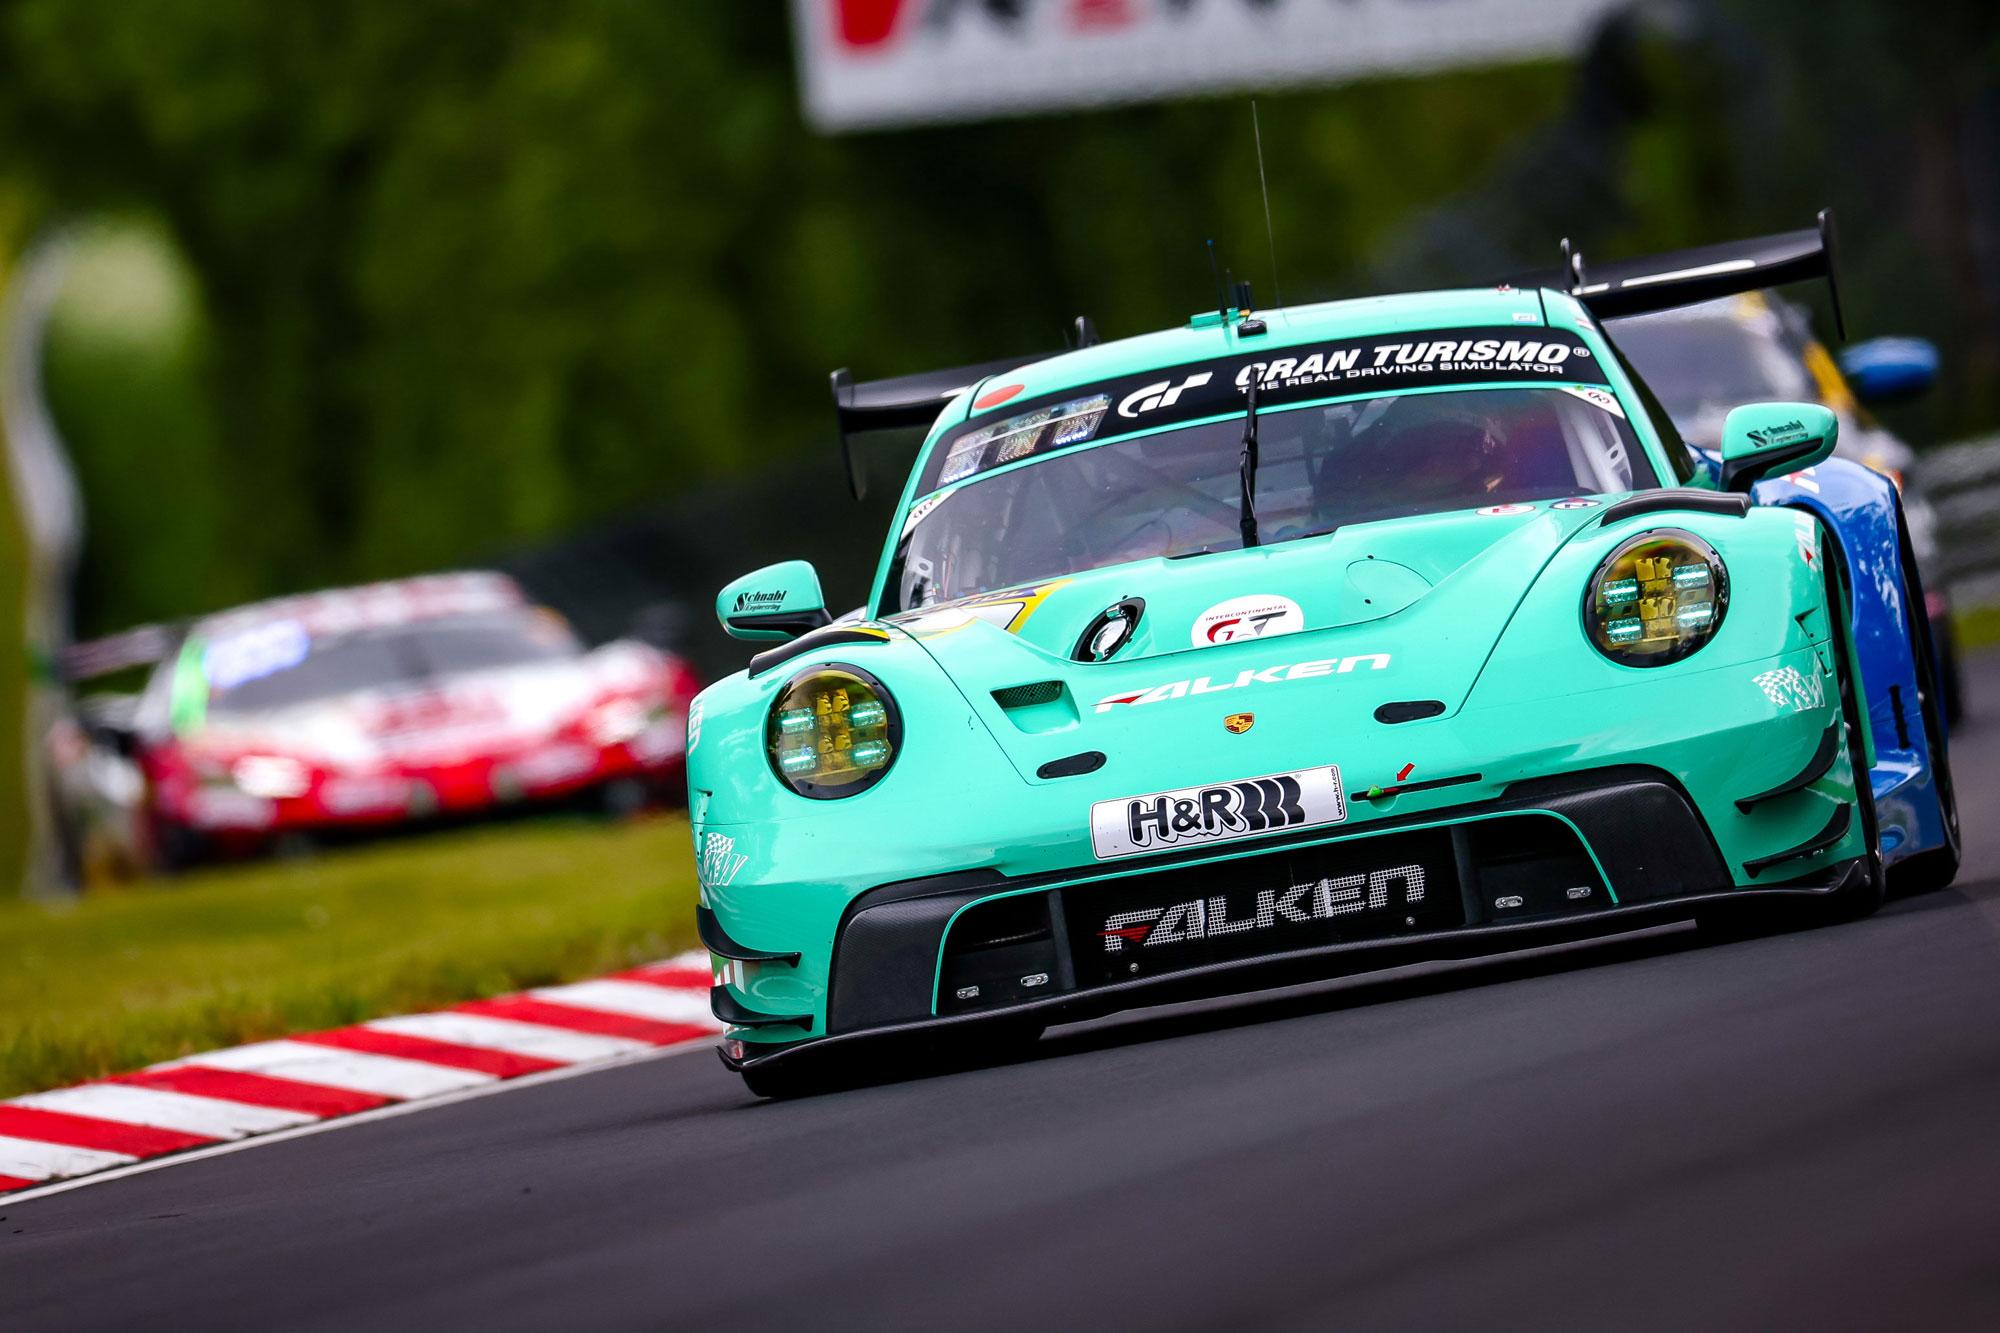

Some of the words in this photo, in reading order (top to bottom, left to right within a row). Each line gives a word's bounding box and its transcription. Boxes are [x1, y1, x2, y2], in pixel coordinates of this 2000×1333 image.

[1235, 349, 1361, 386] GRAN
[1286, 371, 1341, 387] REAL
[1346, 363, 1433, 379] DRIVING
[1439, 361, 1563, 375] SIMULATOR
[1205, 605, 1287, 621] INTERCONTINENTAL
[1092, 654, 1391, 713] FALKEN
[1129, 786, 1241, 845] H&R
[1330, 767, 1344, 816] www.h-r.com
[1099, 865, 1425, 951] FALKEN
